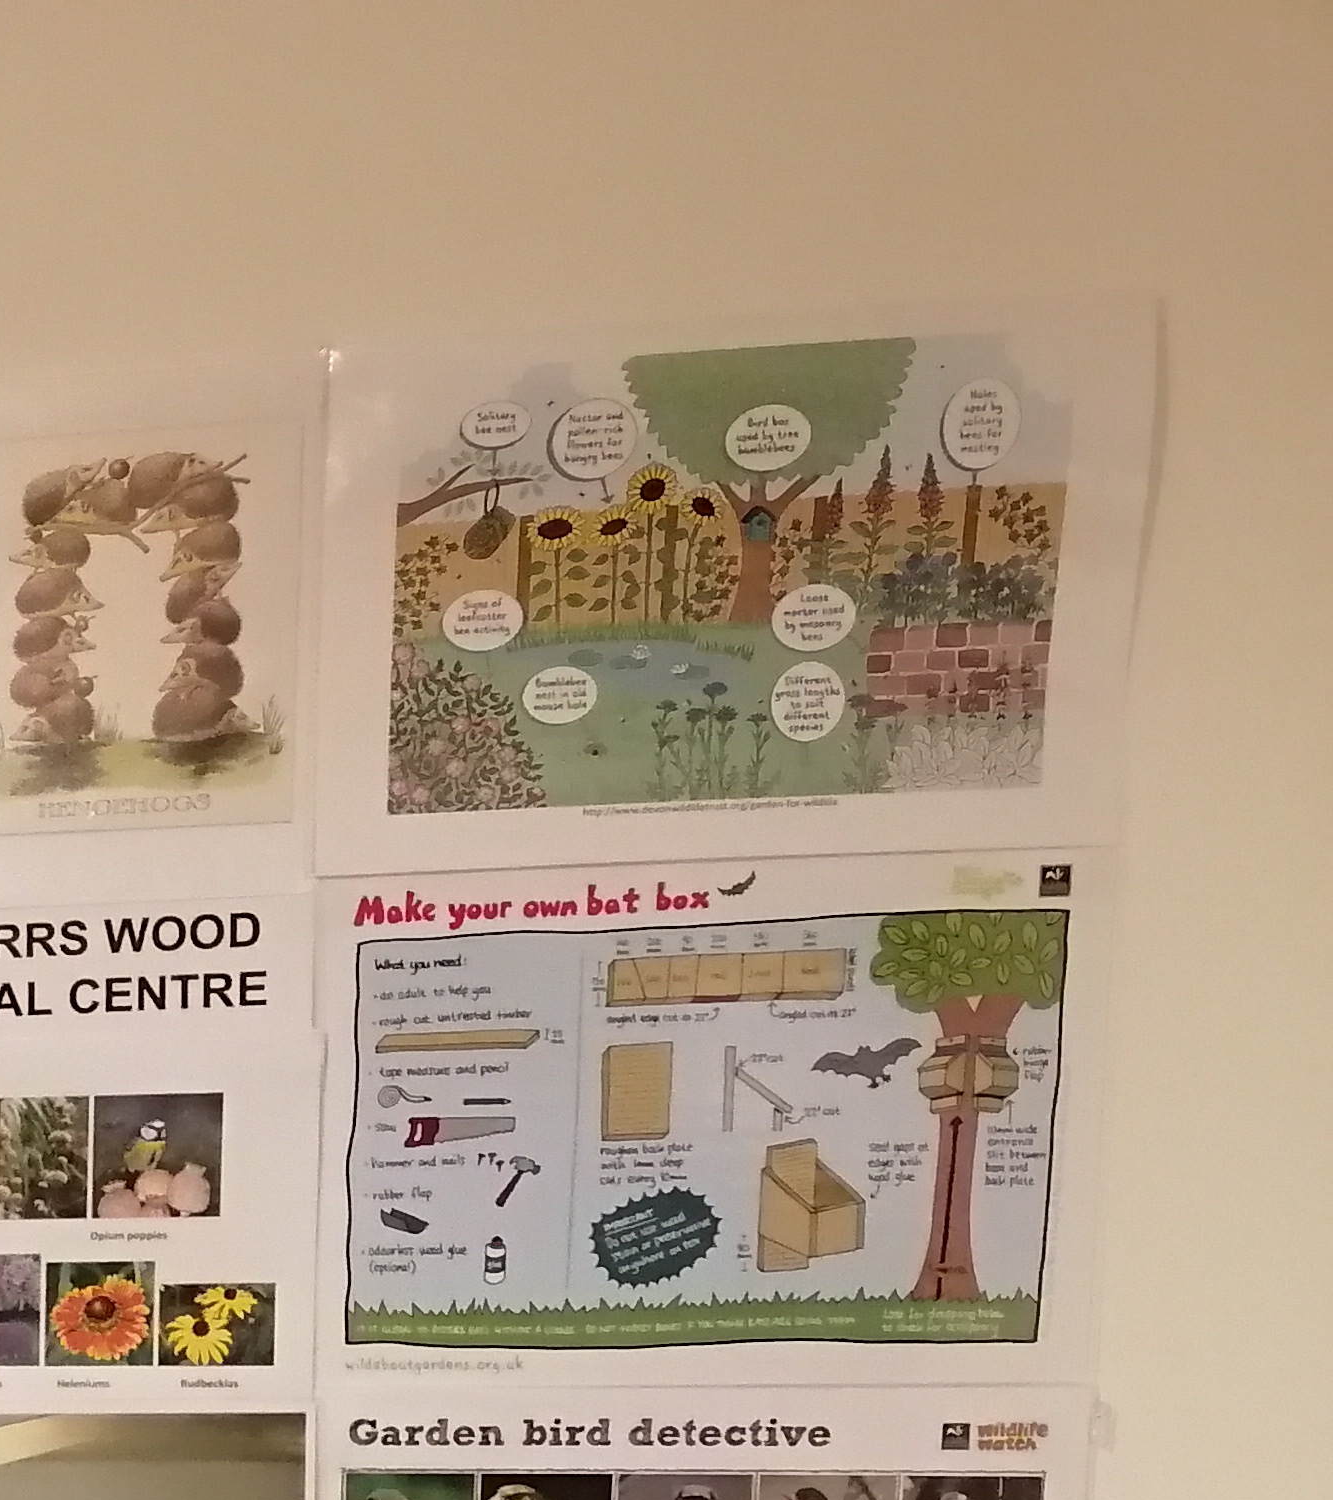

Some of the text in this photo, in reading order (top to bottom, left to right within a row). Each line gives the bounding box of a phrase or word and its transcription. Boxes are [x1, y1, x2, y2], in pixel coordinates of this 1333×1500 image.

[354, 882, 710, 930] Make your own bat box
[103, 911, 261, 954] WOOD
[69, 970, 267, 1015] CENTRE
[348, 1417, 831, 1448] Garden bird detective
